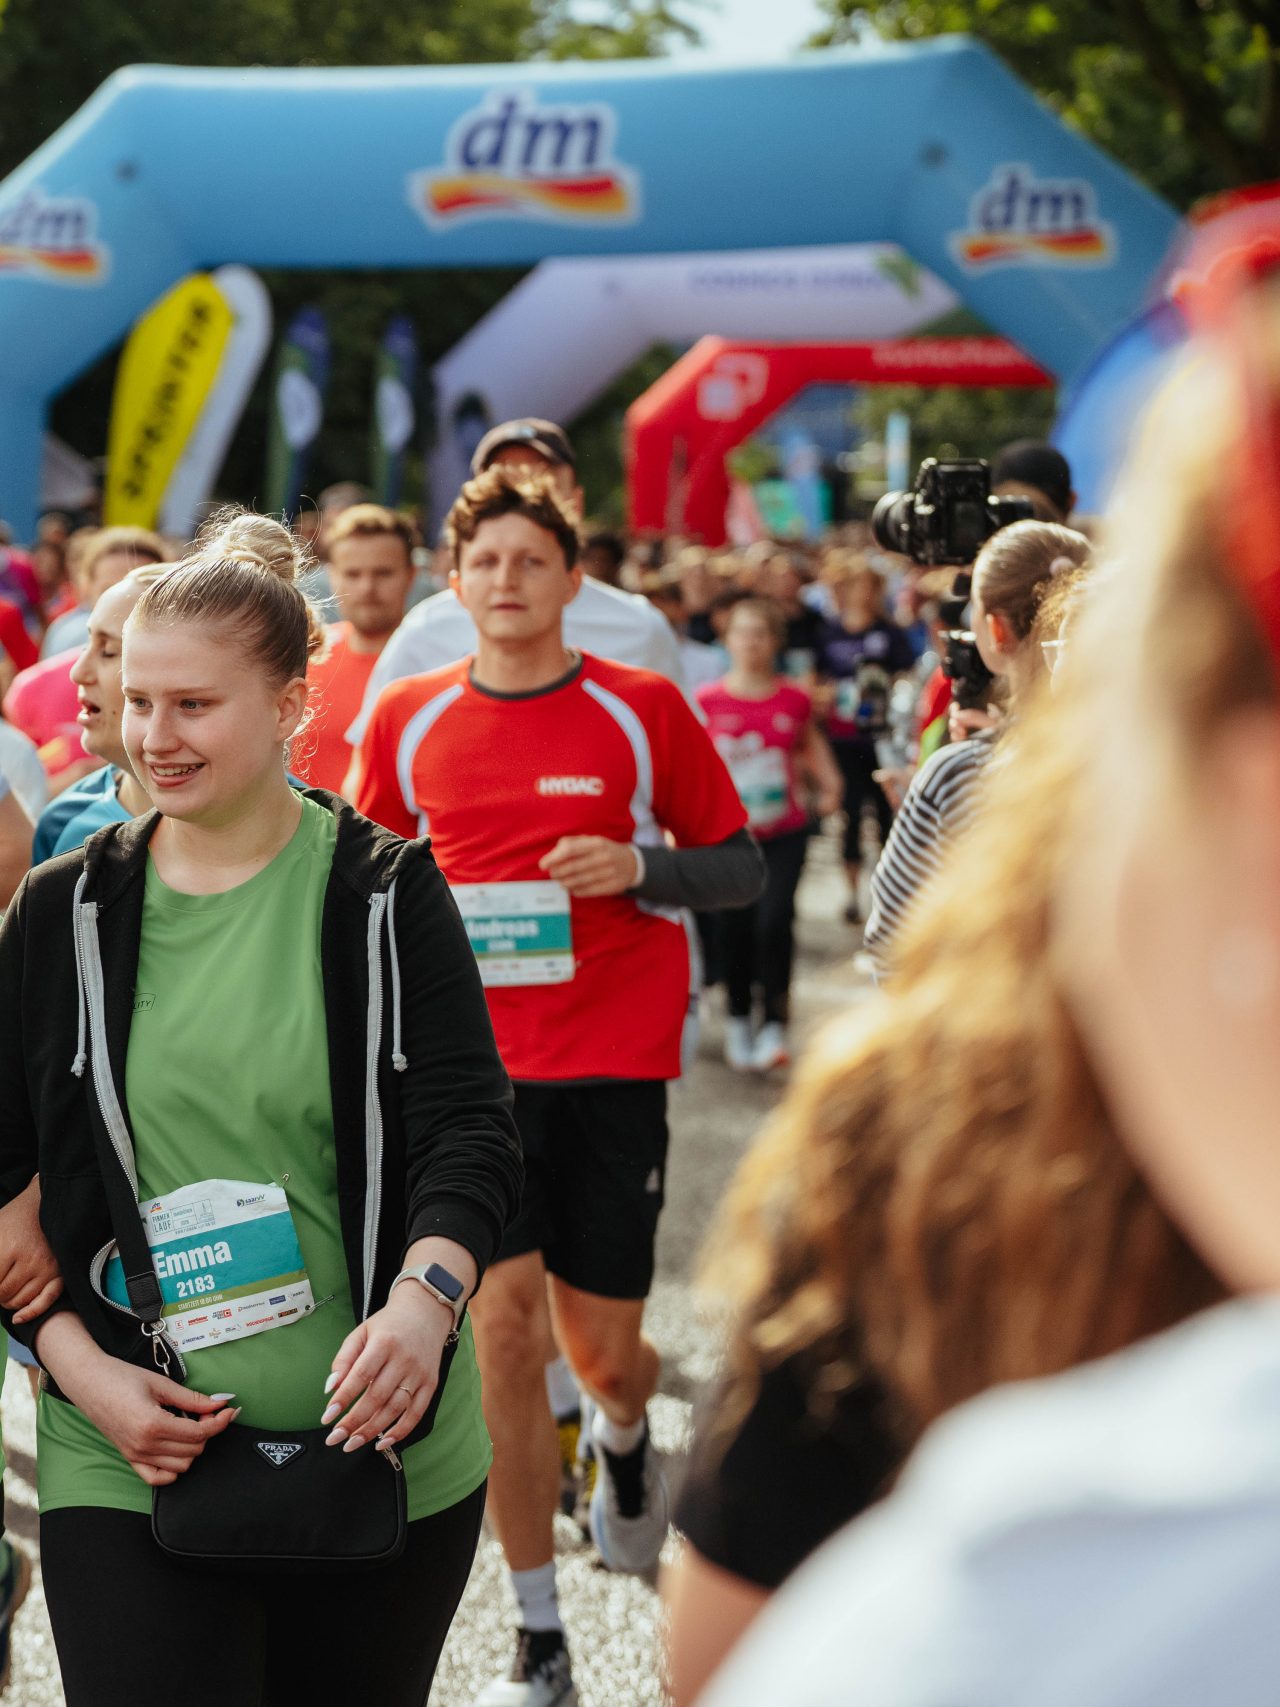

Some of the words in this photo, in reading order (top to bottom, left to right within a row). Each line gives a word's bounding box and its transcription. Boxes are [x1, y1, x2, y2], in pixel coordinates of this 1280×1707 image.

[458, 94, 602, 170] dm
[978, 174, 1085, 232] dm
[538, 777, 604, 796] HYDAC
[154, 1221, 171, 1233] LAUF
[153, 1240, 233, 1279] Emma
[176, 1274, 216, 1298] 2183
[265, 1444, 294, 1452] PRADA
